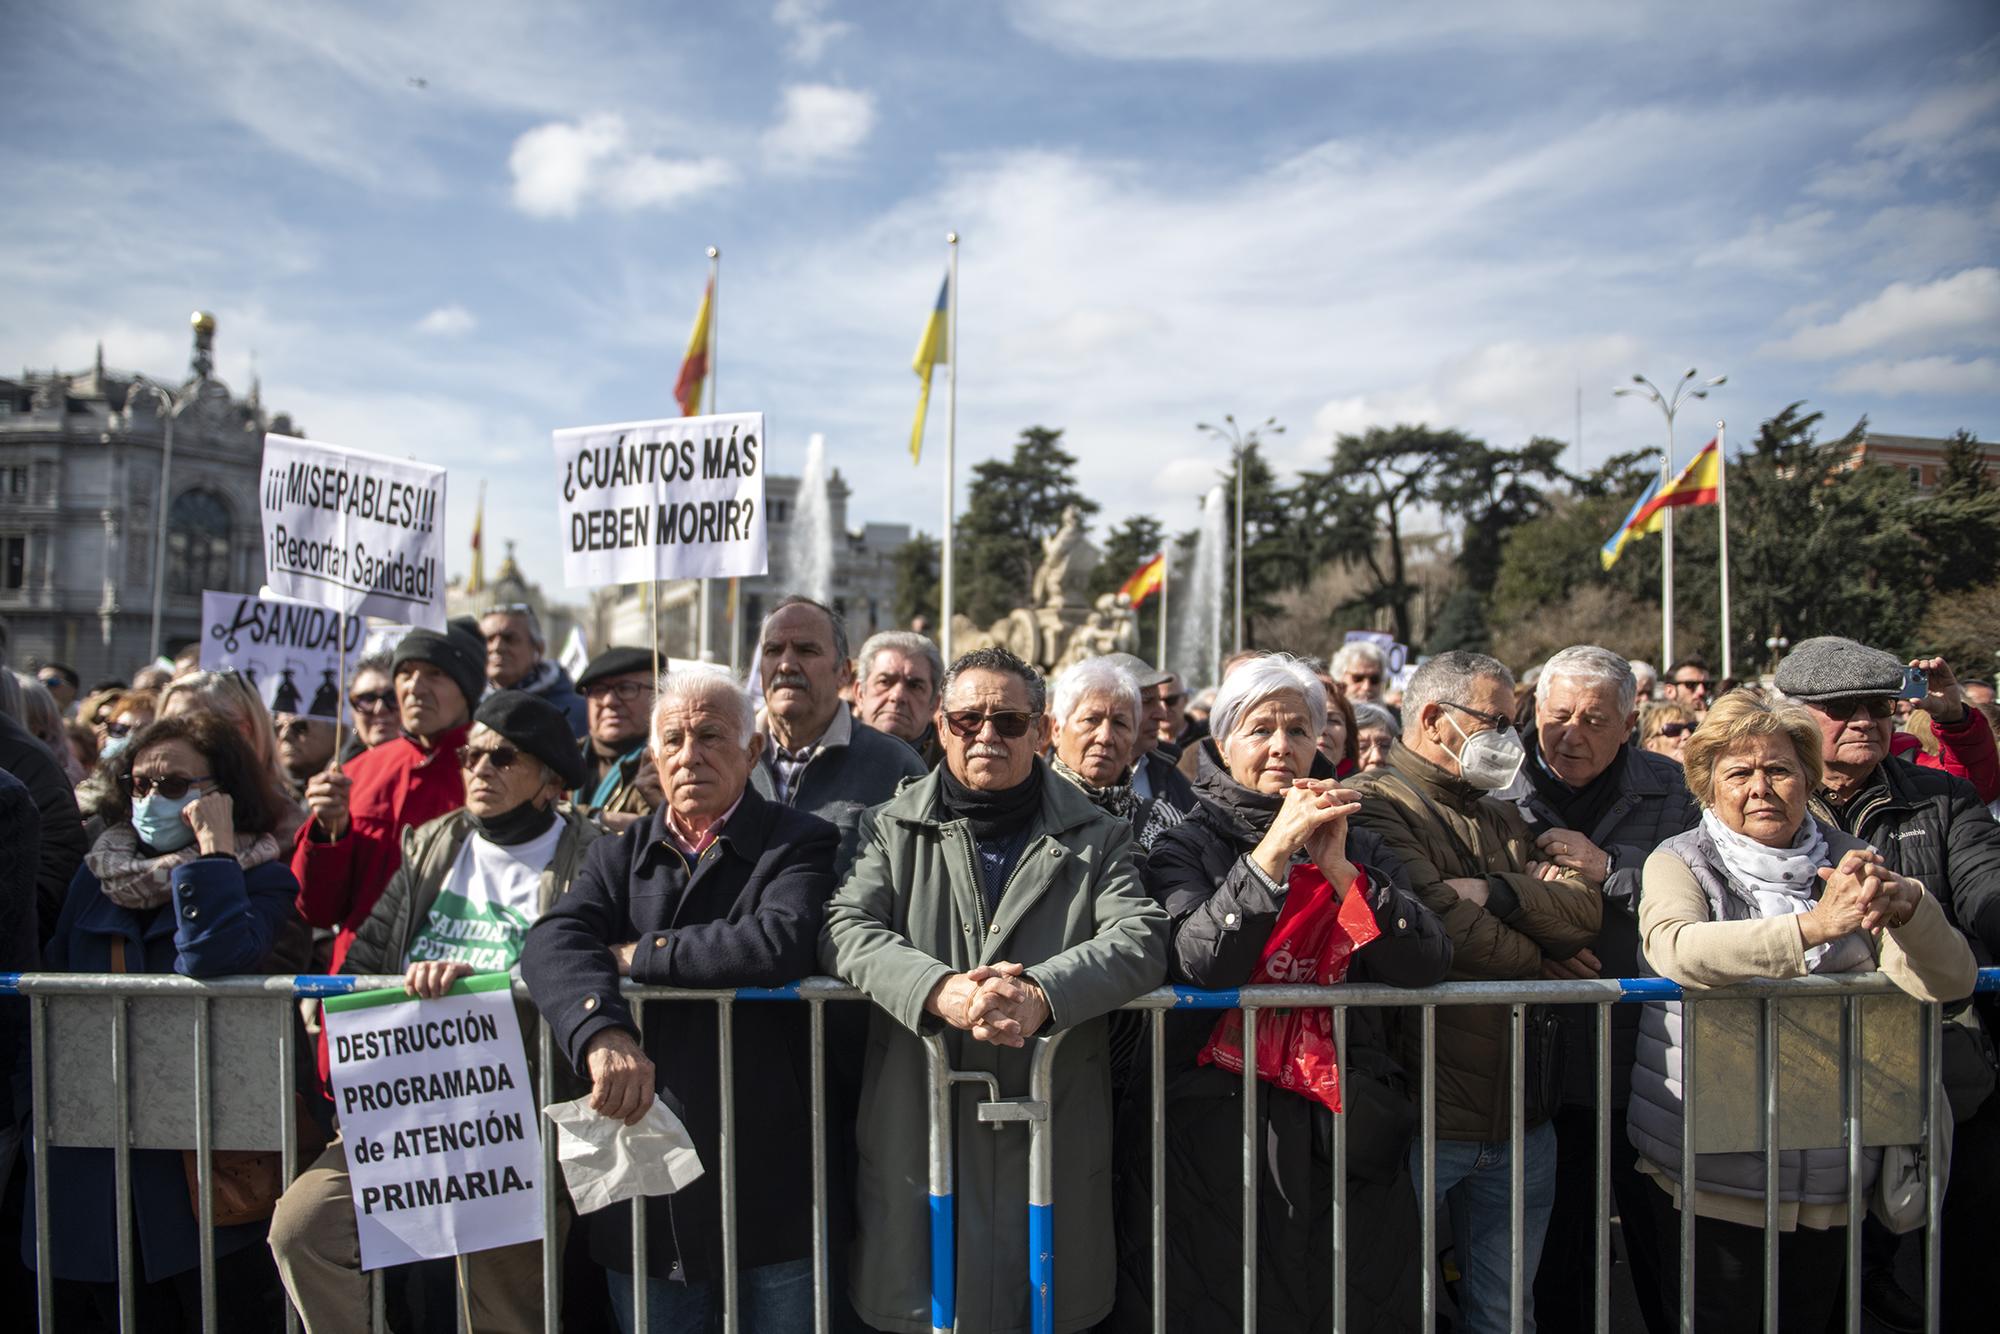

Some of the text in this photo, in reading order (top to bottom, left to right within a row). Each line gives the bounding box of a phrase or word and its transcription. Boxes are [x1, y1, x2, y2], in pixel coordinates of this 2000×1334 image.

[564, 425, 758, 502] ¿CUÁNTOS MÁS
[266, 461, 437, 533] ¡¡¡MISERABLES!!!
[572, 498, 754, 552] DEBEN MORIR?
[270, 524, 435, 599] ¡Recortan Sanidad!
[250, 602, 361, 652] SANIDAD
[336, 1010, 498, 1063] DESTRUCCIÓN
[343, 1063, 515, 1114] PROGRAMADA
[355, 1110, 524, 1164] de ATENCIÓN
[361, 1166, 533, 1215] PRIMARIA.
